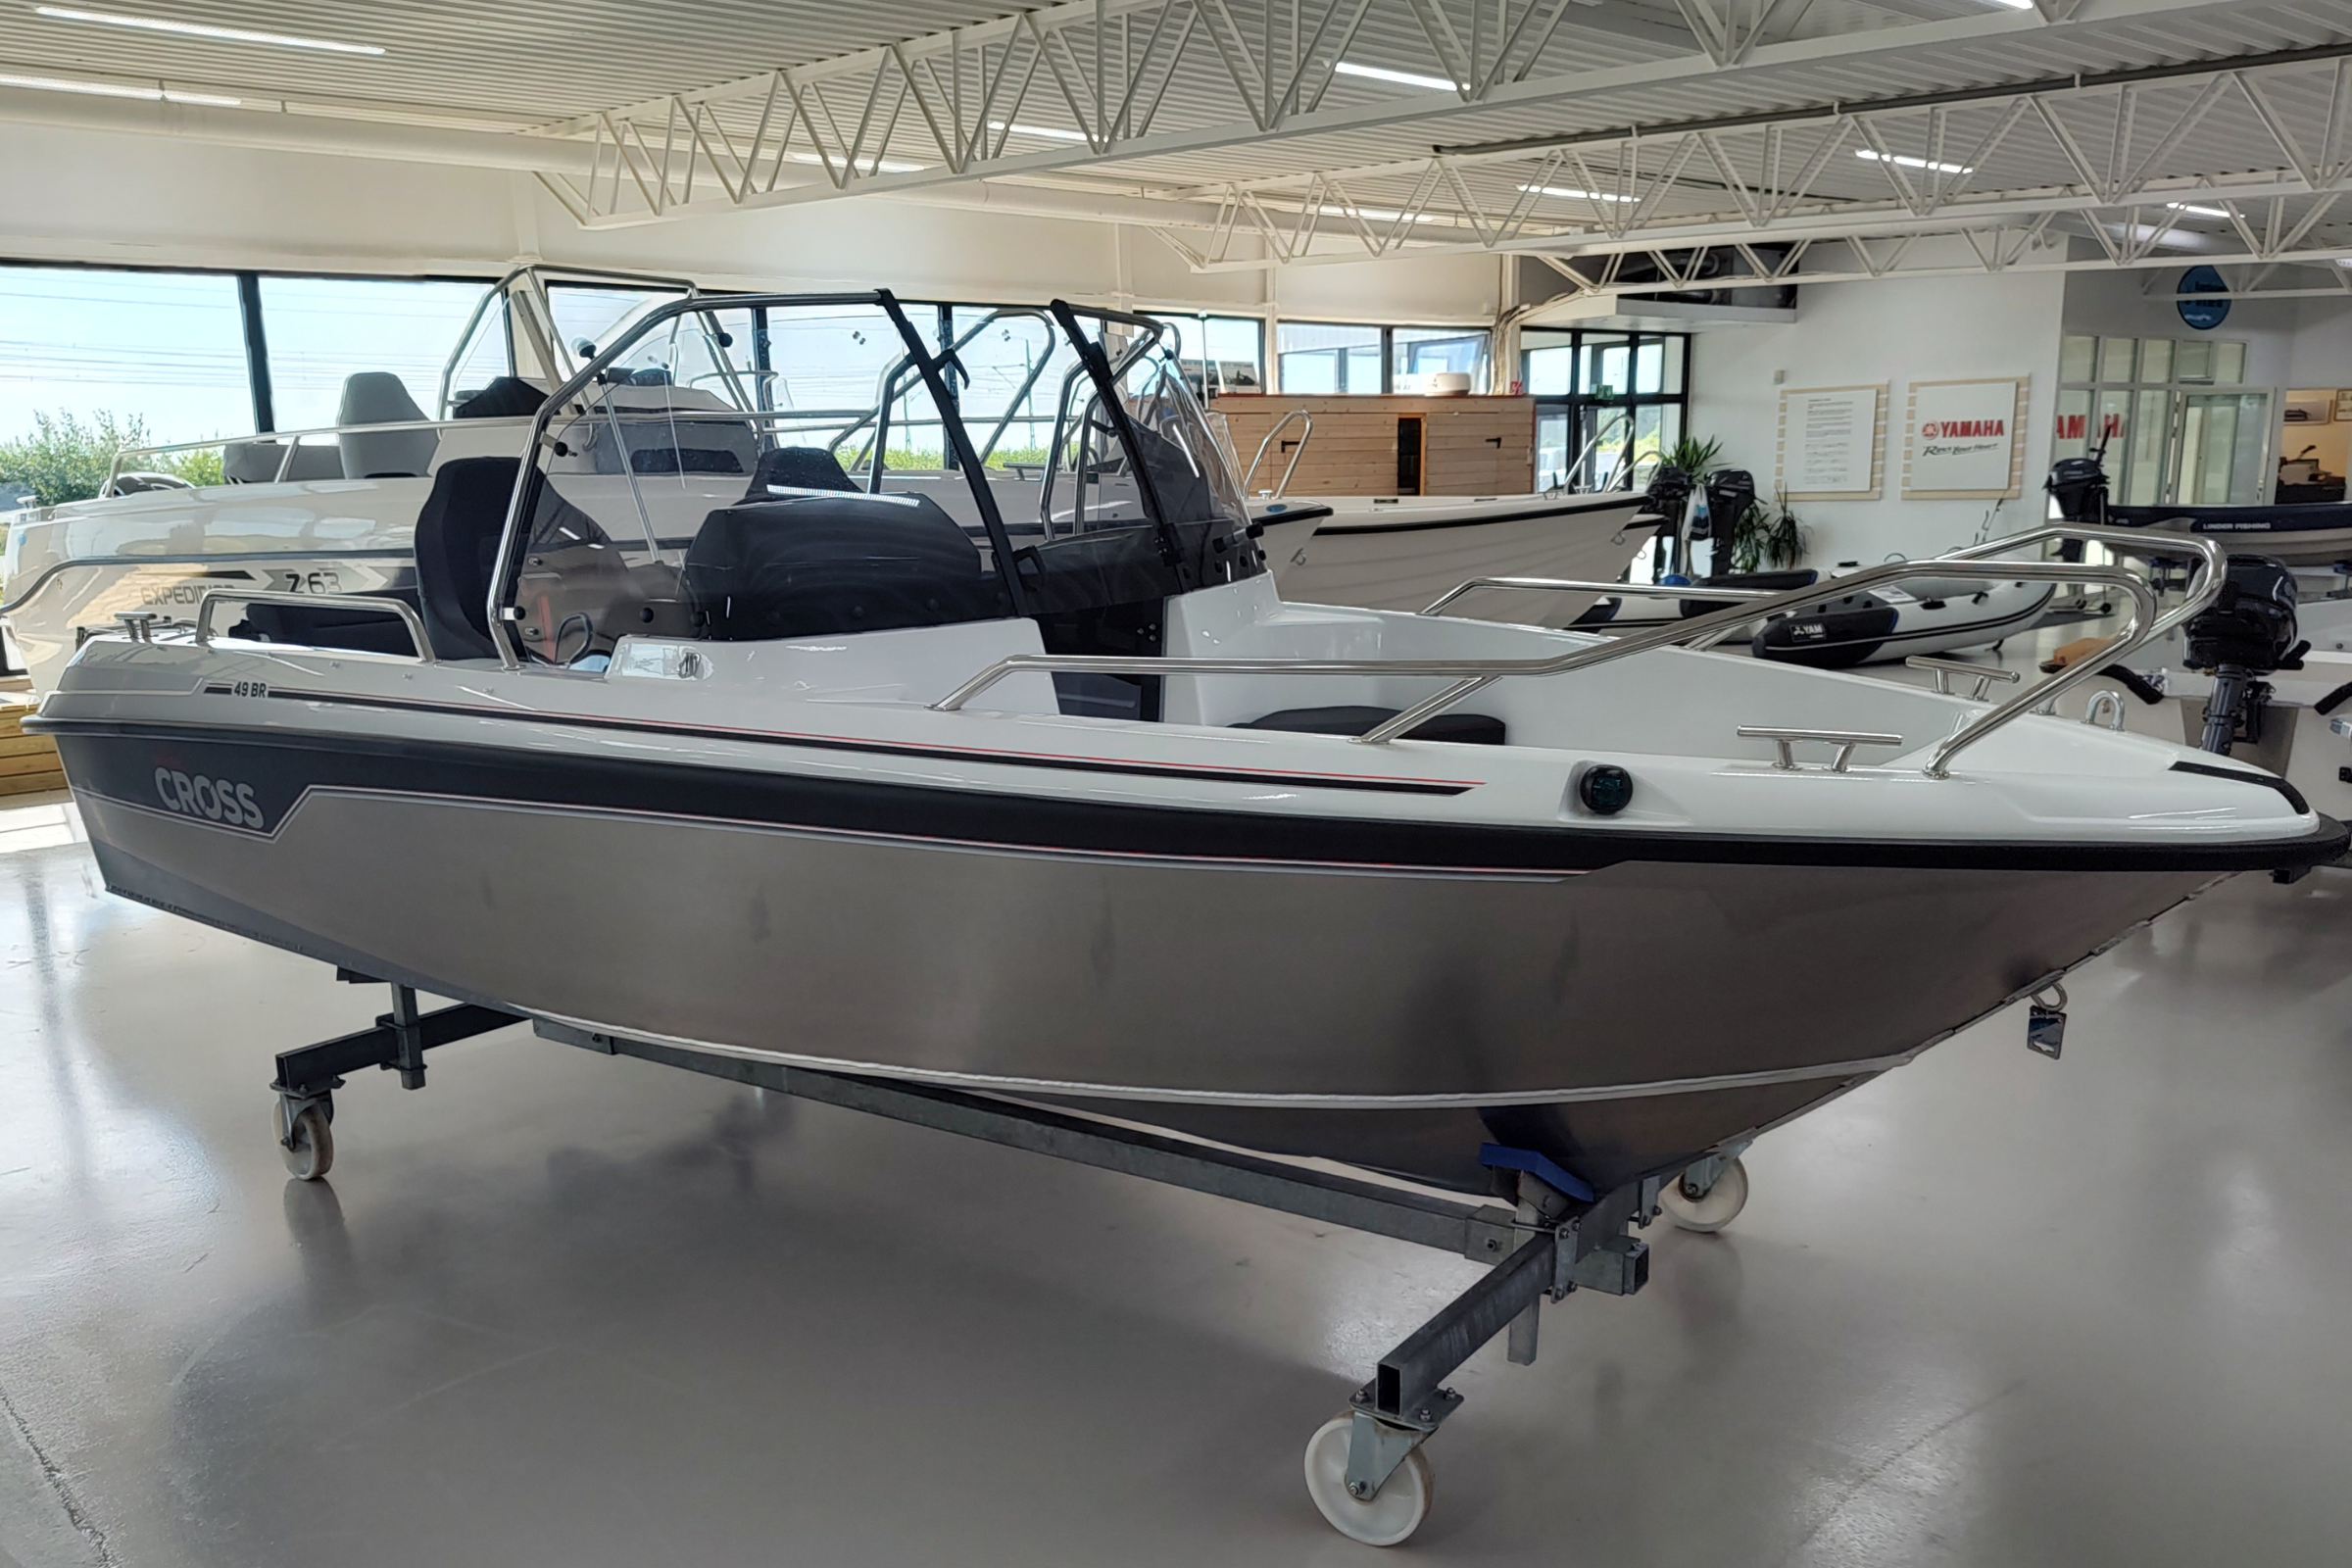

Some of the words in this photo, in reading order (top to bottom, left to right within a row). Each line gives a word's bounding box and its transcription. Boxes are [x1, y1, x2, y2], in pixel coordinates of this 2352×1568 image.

[1940, 419, 2005, 438] YAMAHA
[234, 681, 249, 698] 49
[251, 682, 267, 699] BR
[155, 766, 265, 829] CROSS
